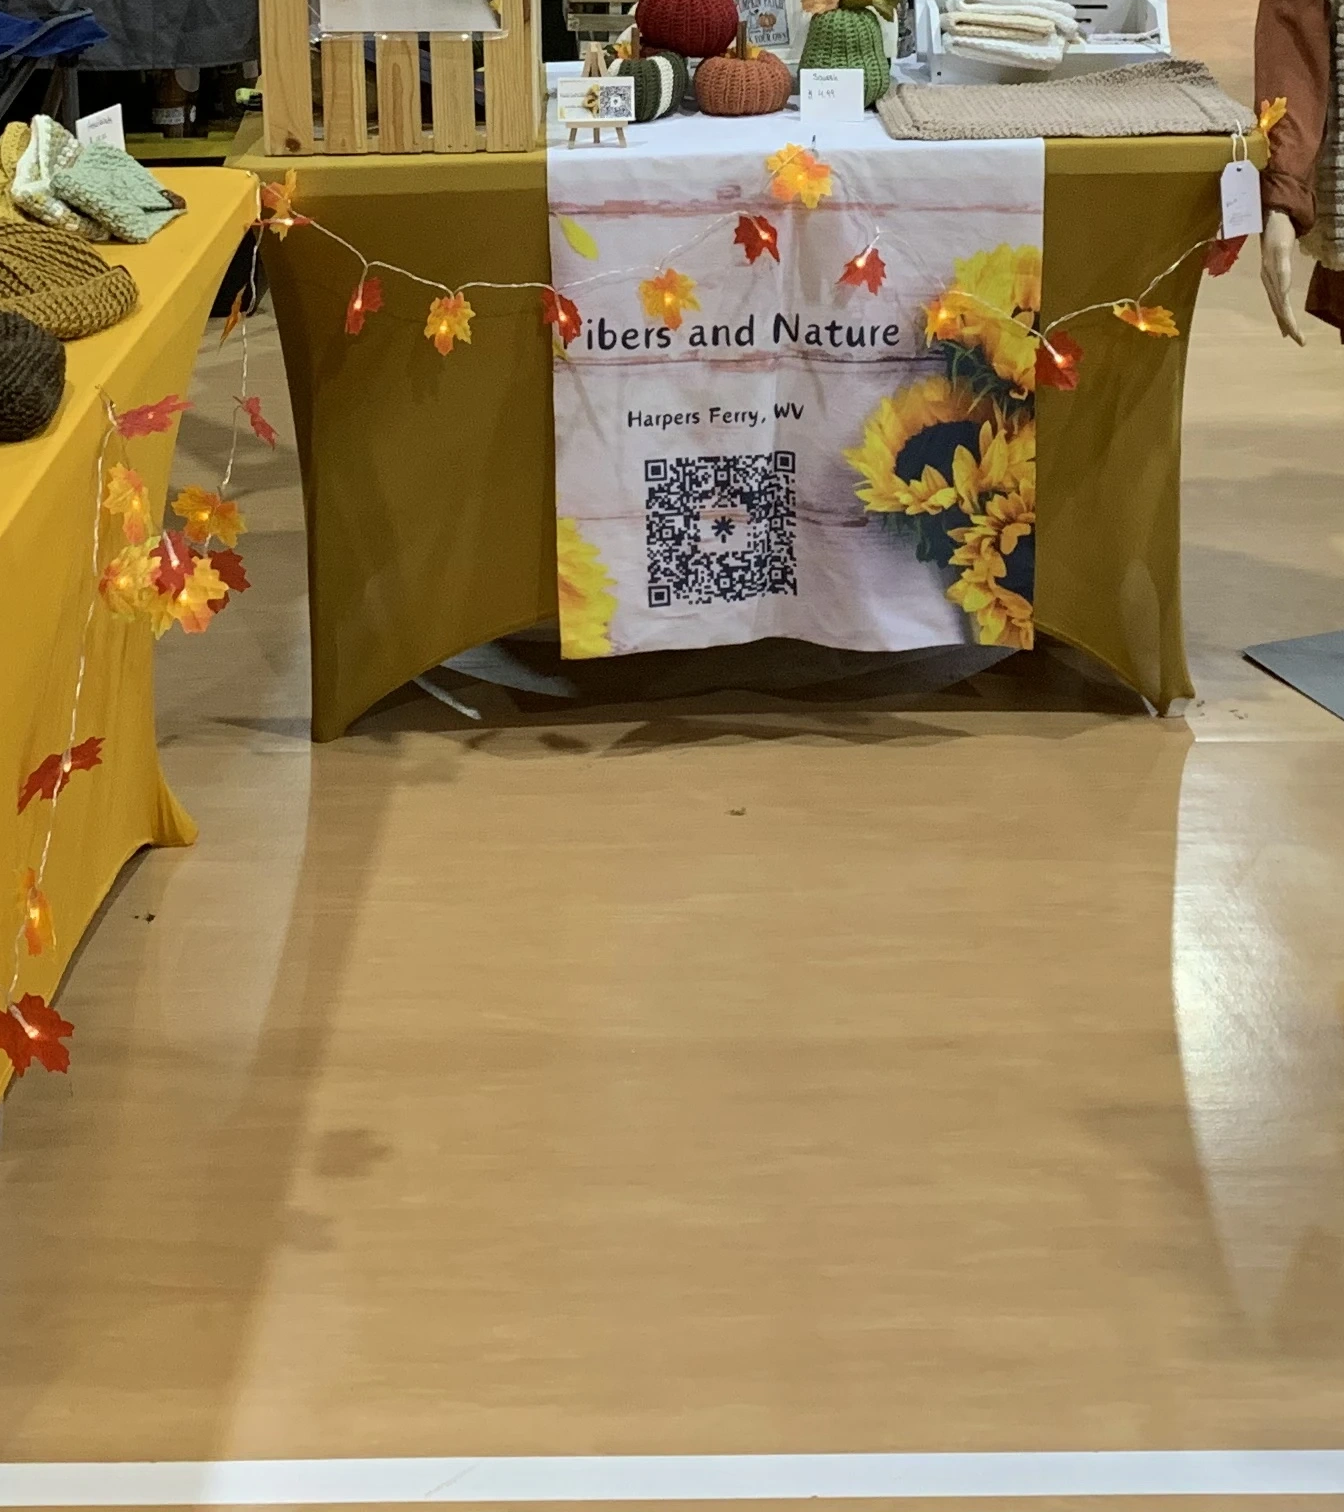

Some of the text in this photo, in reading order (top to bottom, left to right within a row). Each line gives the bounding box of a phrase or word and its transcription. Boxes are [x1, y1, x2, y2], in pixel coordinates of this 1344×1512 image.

[563, 313, 901, 350] ibers and Nature
[627, 402, 805, 430] Harpers Ferry, WV
